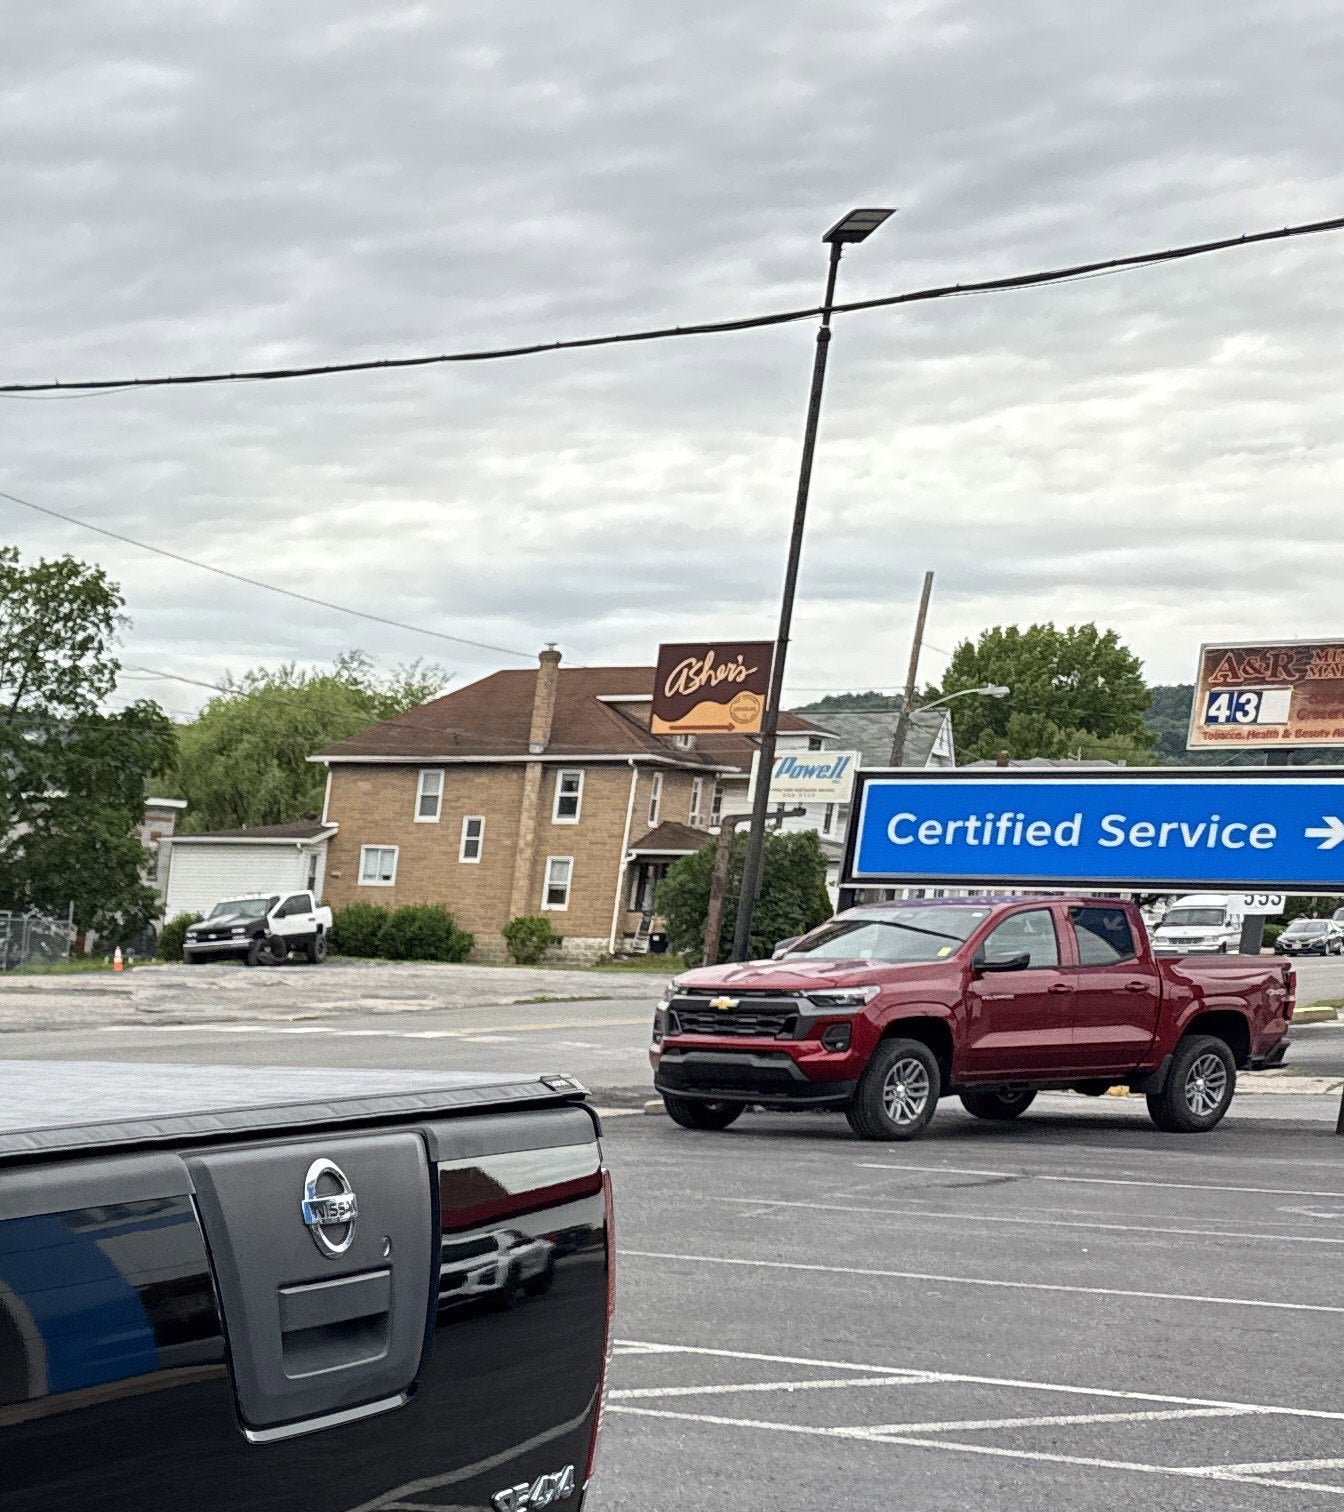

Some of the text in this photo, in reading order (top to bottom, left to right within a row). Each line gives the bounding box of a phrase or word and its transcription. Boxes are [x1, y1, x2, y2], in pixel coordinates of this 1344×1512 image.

[774, 756, 851, 779] Powell
[886, 812, 1278, 850] Certified Service
